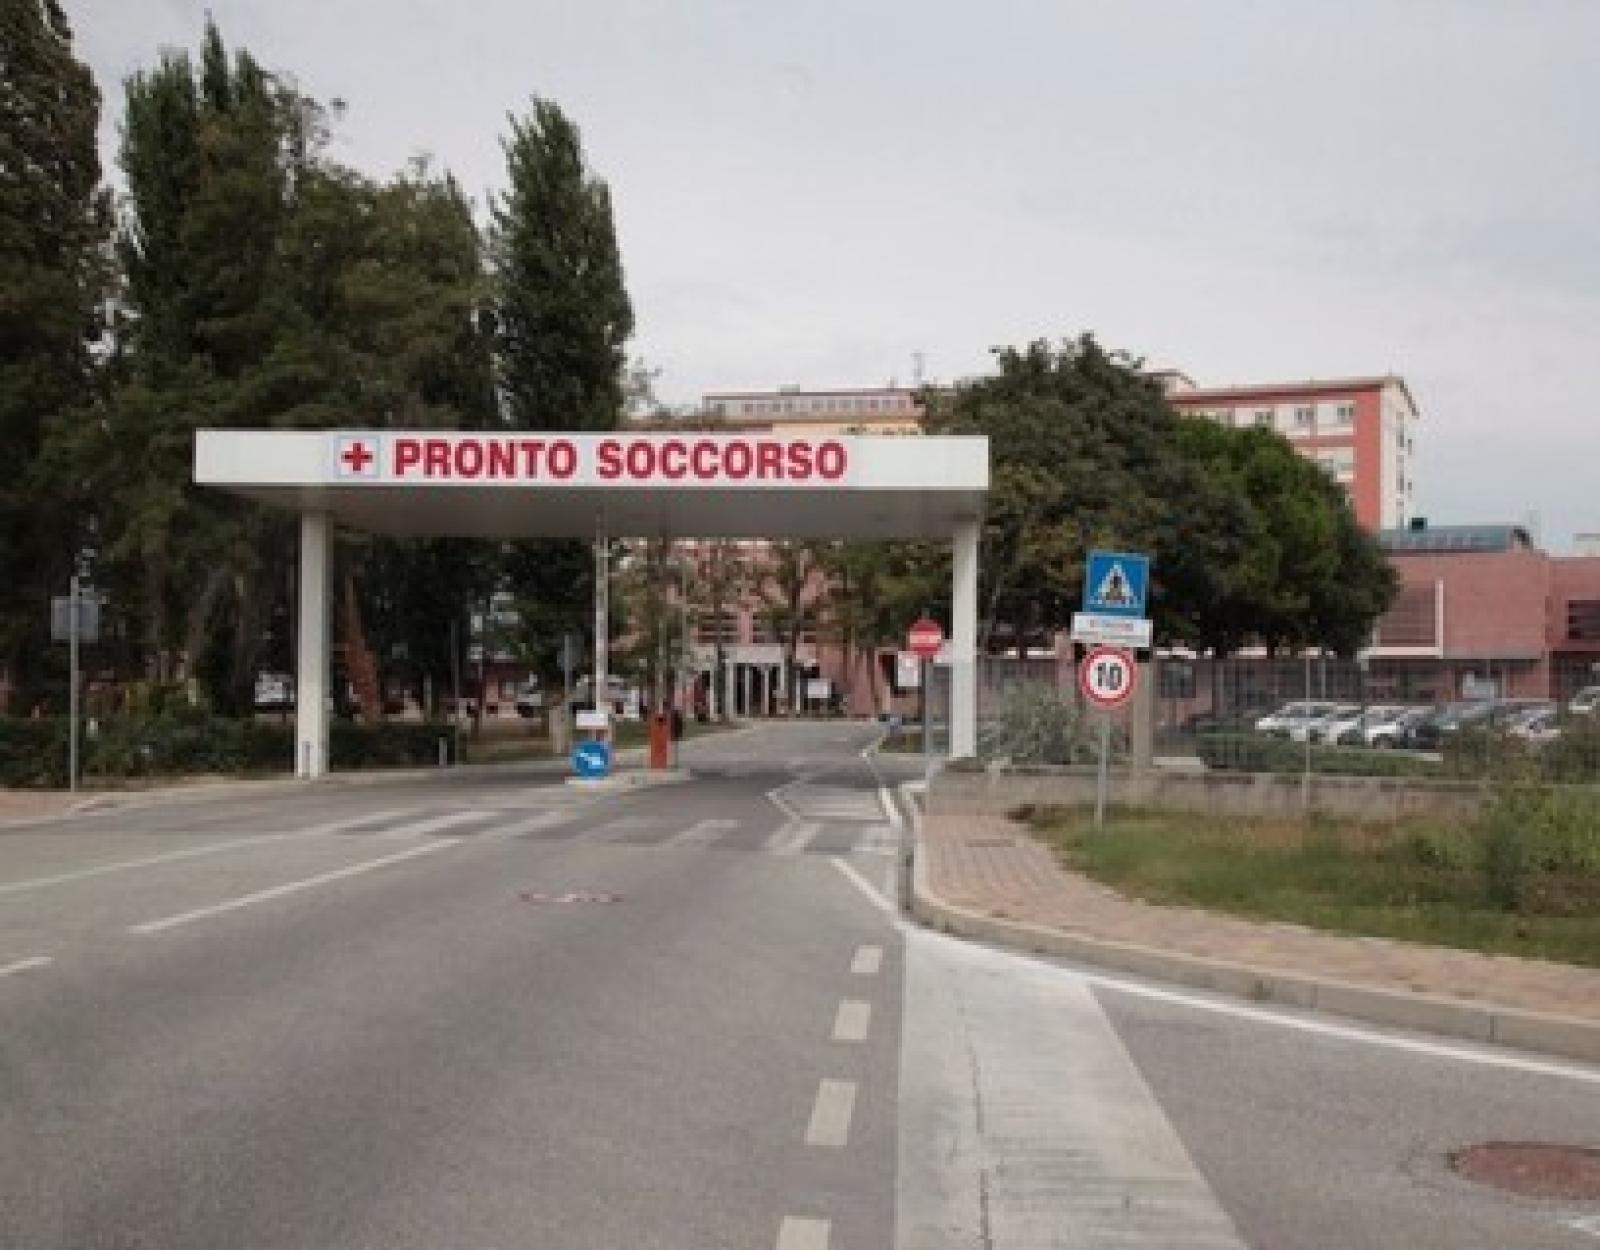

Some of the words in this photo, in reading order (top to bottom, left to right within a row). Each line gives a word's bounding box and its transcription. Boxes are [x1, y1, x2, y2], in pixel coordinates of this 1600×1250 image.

[392, 438, 577, 480] PRONTO
[596, 439, 848, 480] SOCCORSO
[1097, 661, 1123, 691] 10
